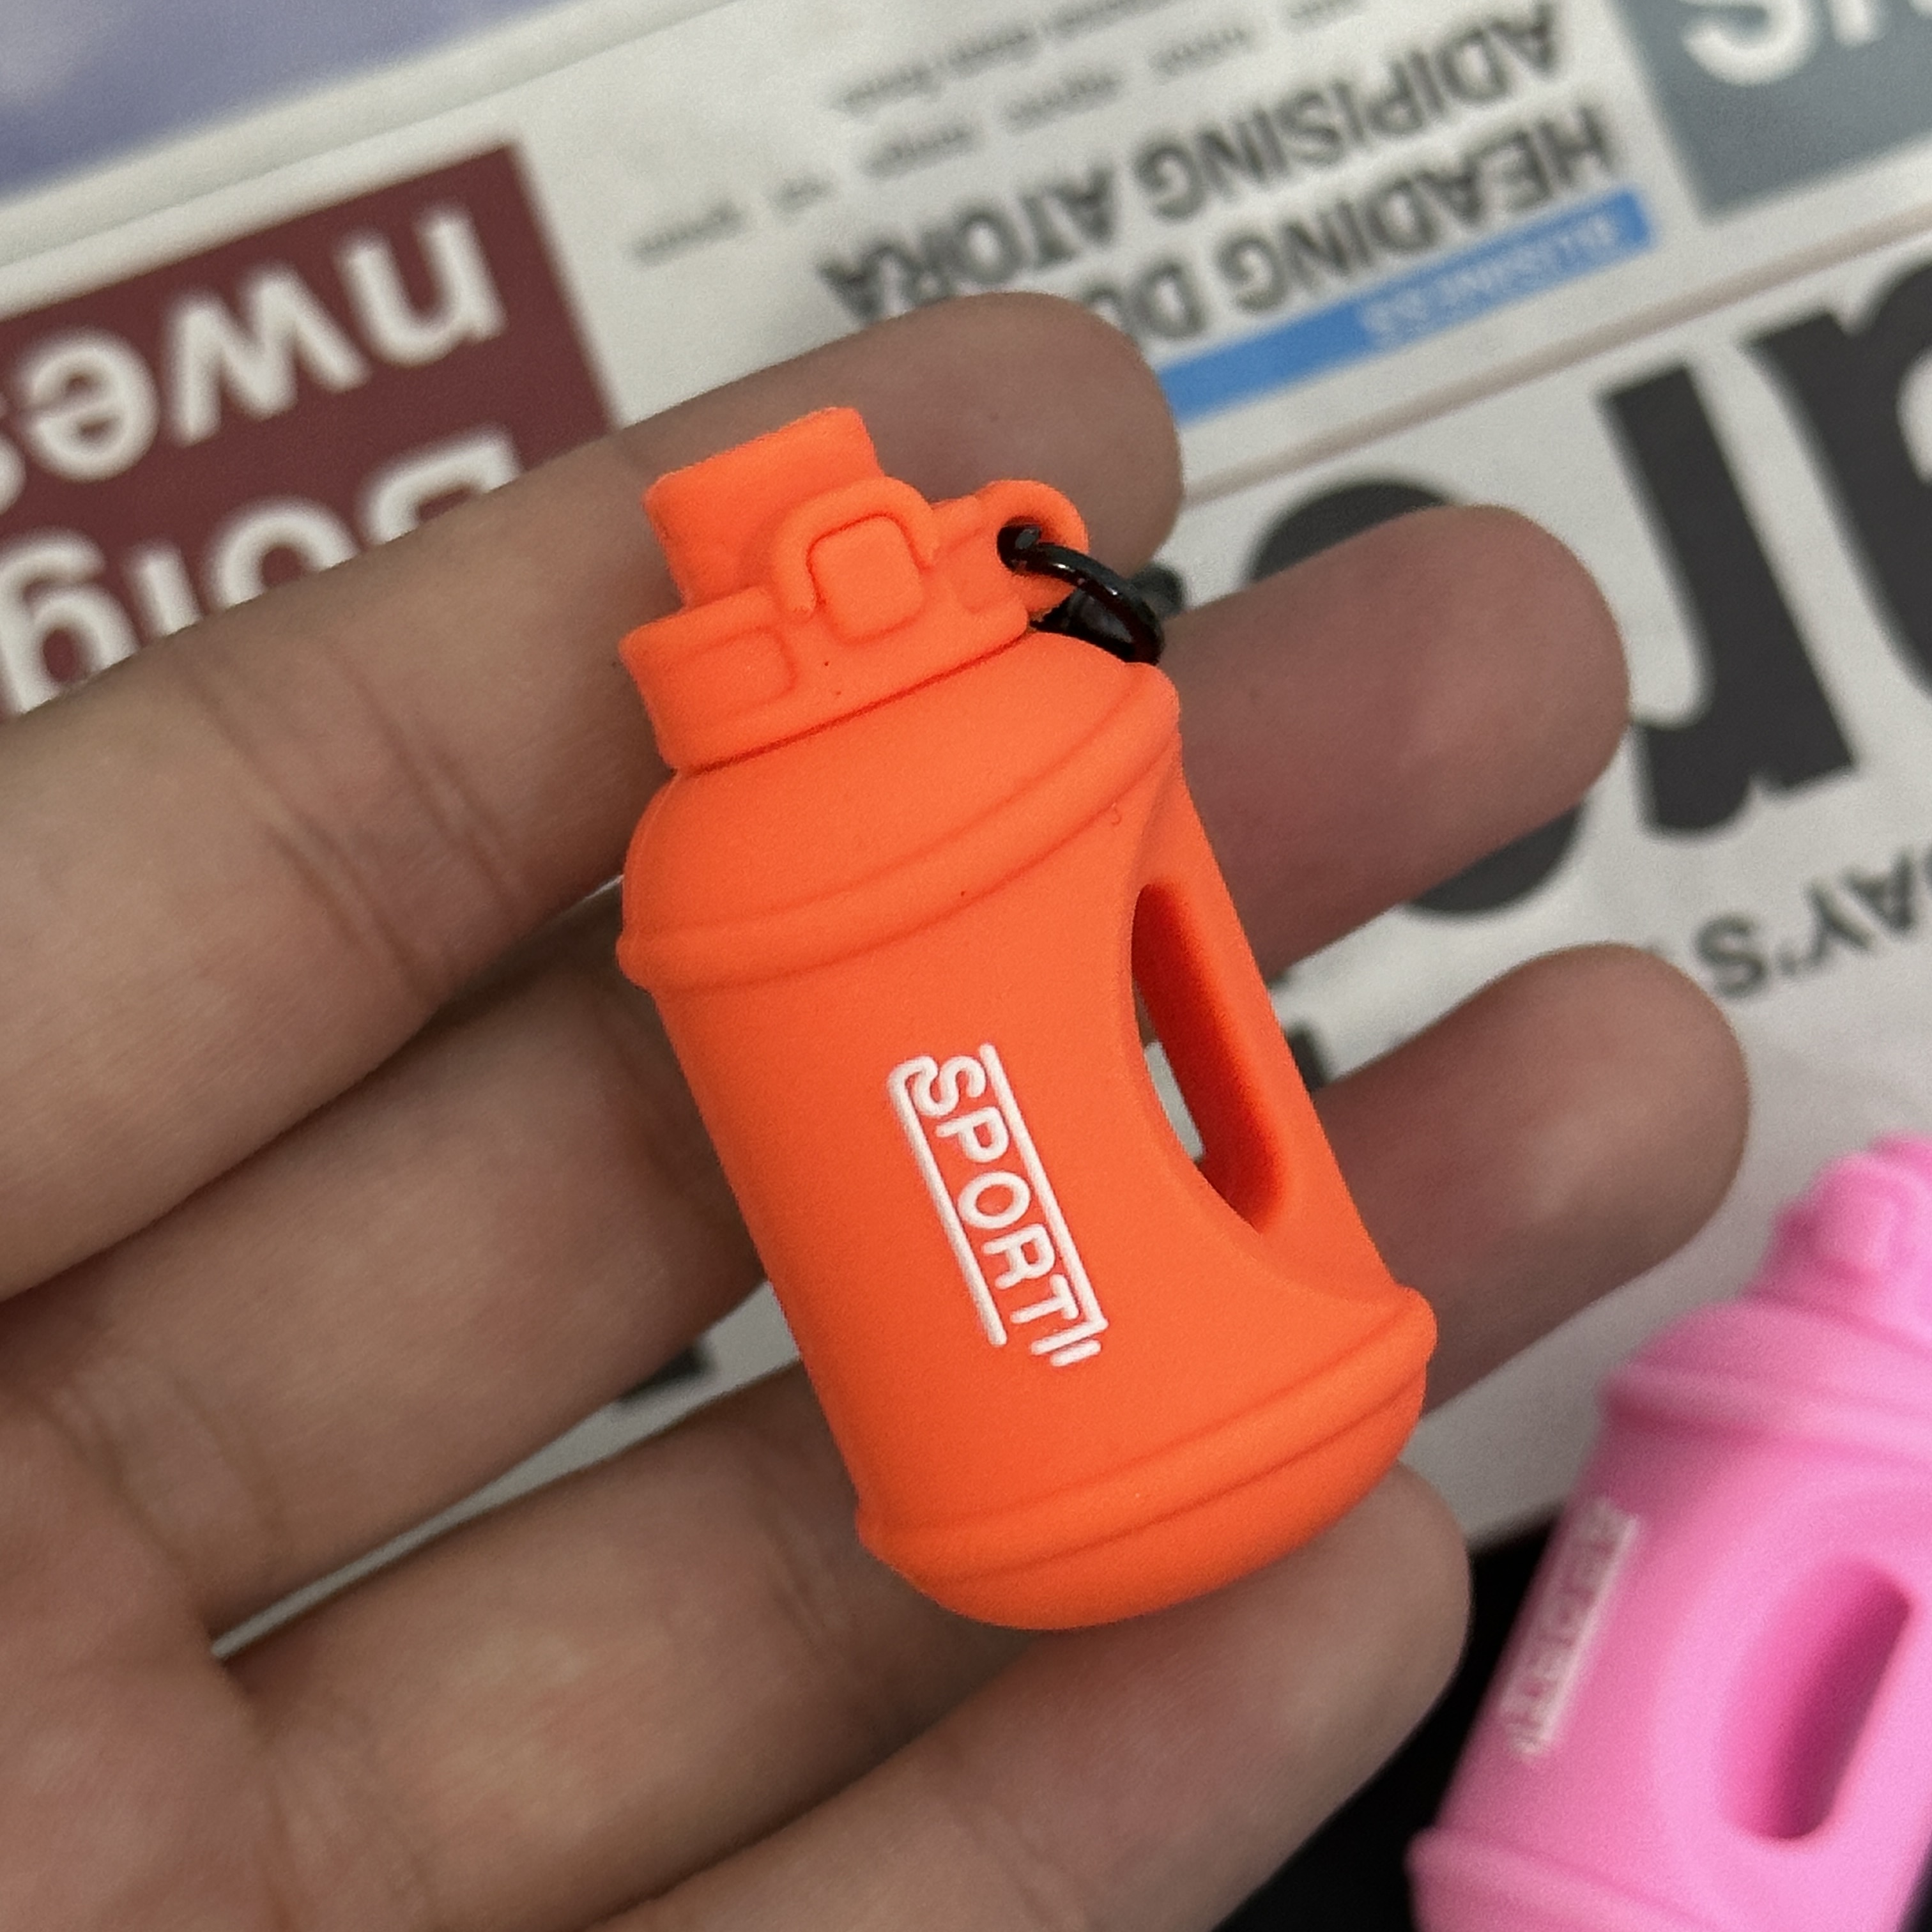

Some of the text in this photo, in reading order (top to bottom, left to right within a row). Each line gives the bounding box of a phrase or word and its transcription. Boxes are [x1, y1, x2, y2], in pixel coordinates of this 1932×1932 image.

[1136, 1, 1559, 222] ADIPISING
[1214, 99, 1616, 313] HEADING
[1693, 848, 1932, 1000] AY'S
[907, 1054, 1081, 1325] SPORT
